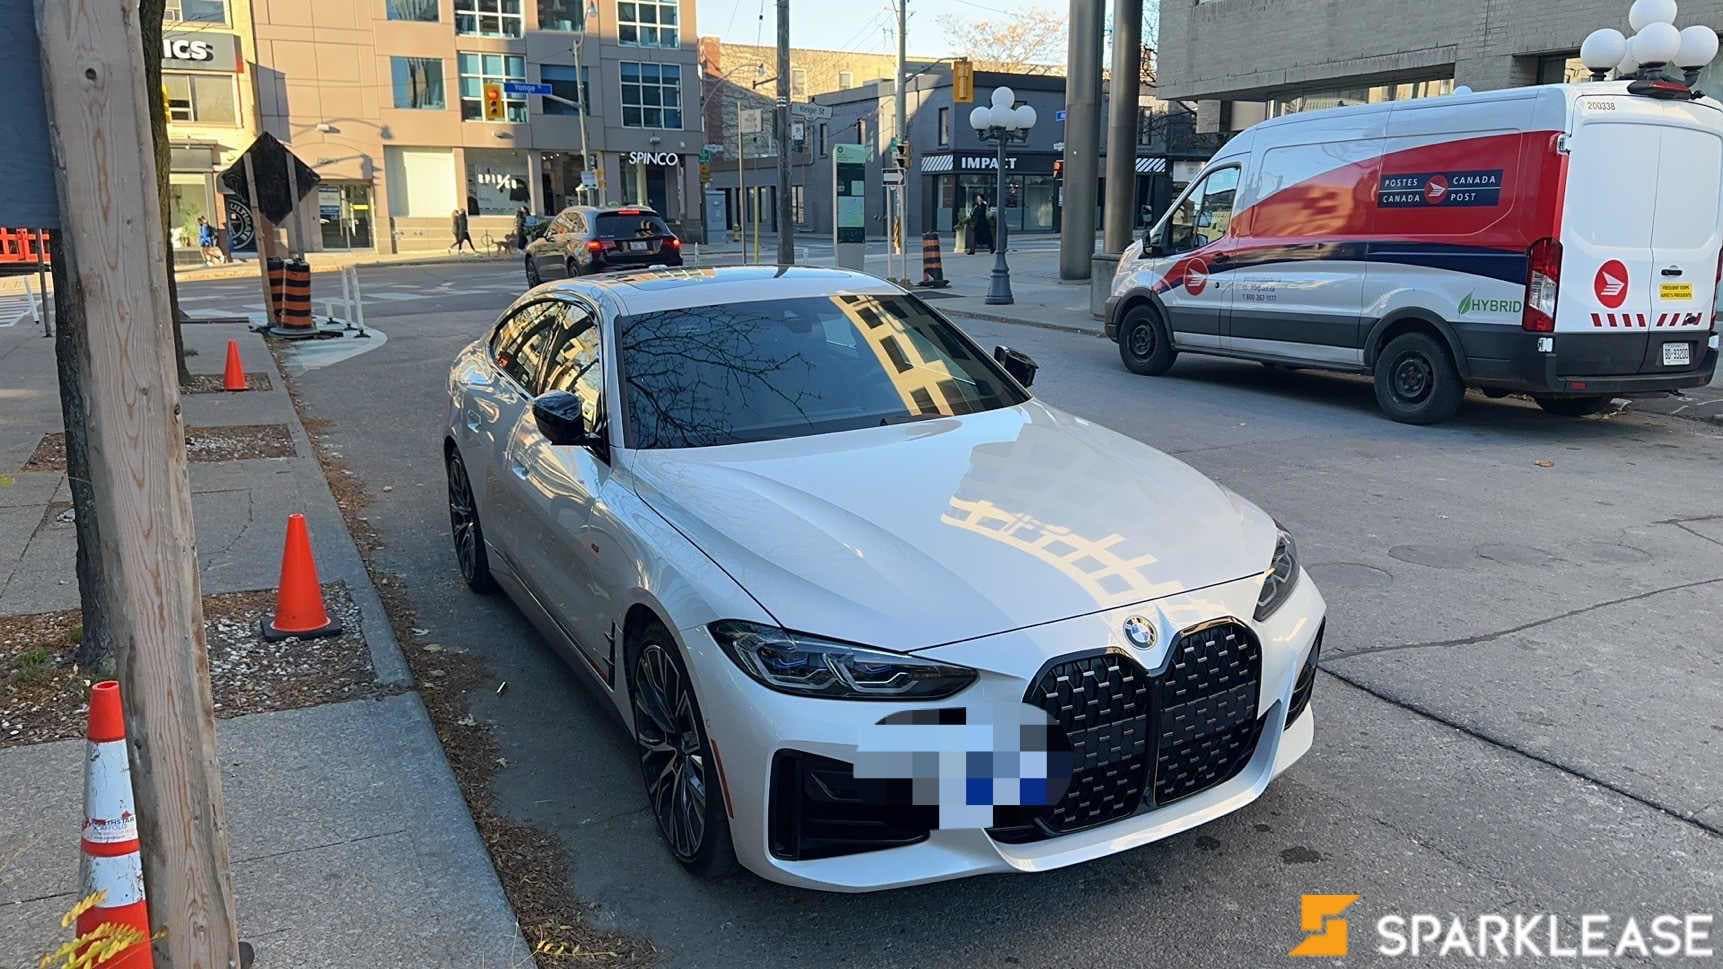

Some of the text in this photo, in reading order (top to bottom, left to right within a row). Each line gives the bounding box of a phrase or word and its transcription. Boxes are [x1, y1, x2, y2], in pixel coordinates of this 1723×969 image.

[1587, 101, 1616, 111] 200338
[629, 151, 679, 166] SPINCO
[1384, 175, 1496, 187] POSTES CANADA
[1382, 192, 1477, 203] CANADA POST
[1472, 299, 1522, 313] HYBRID
